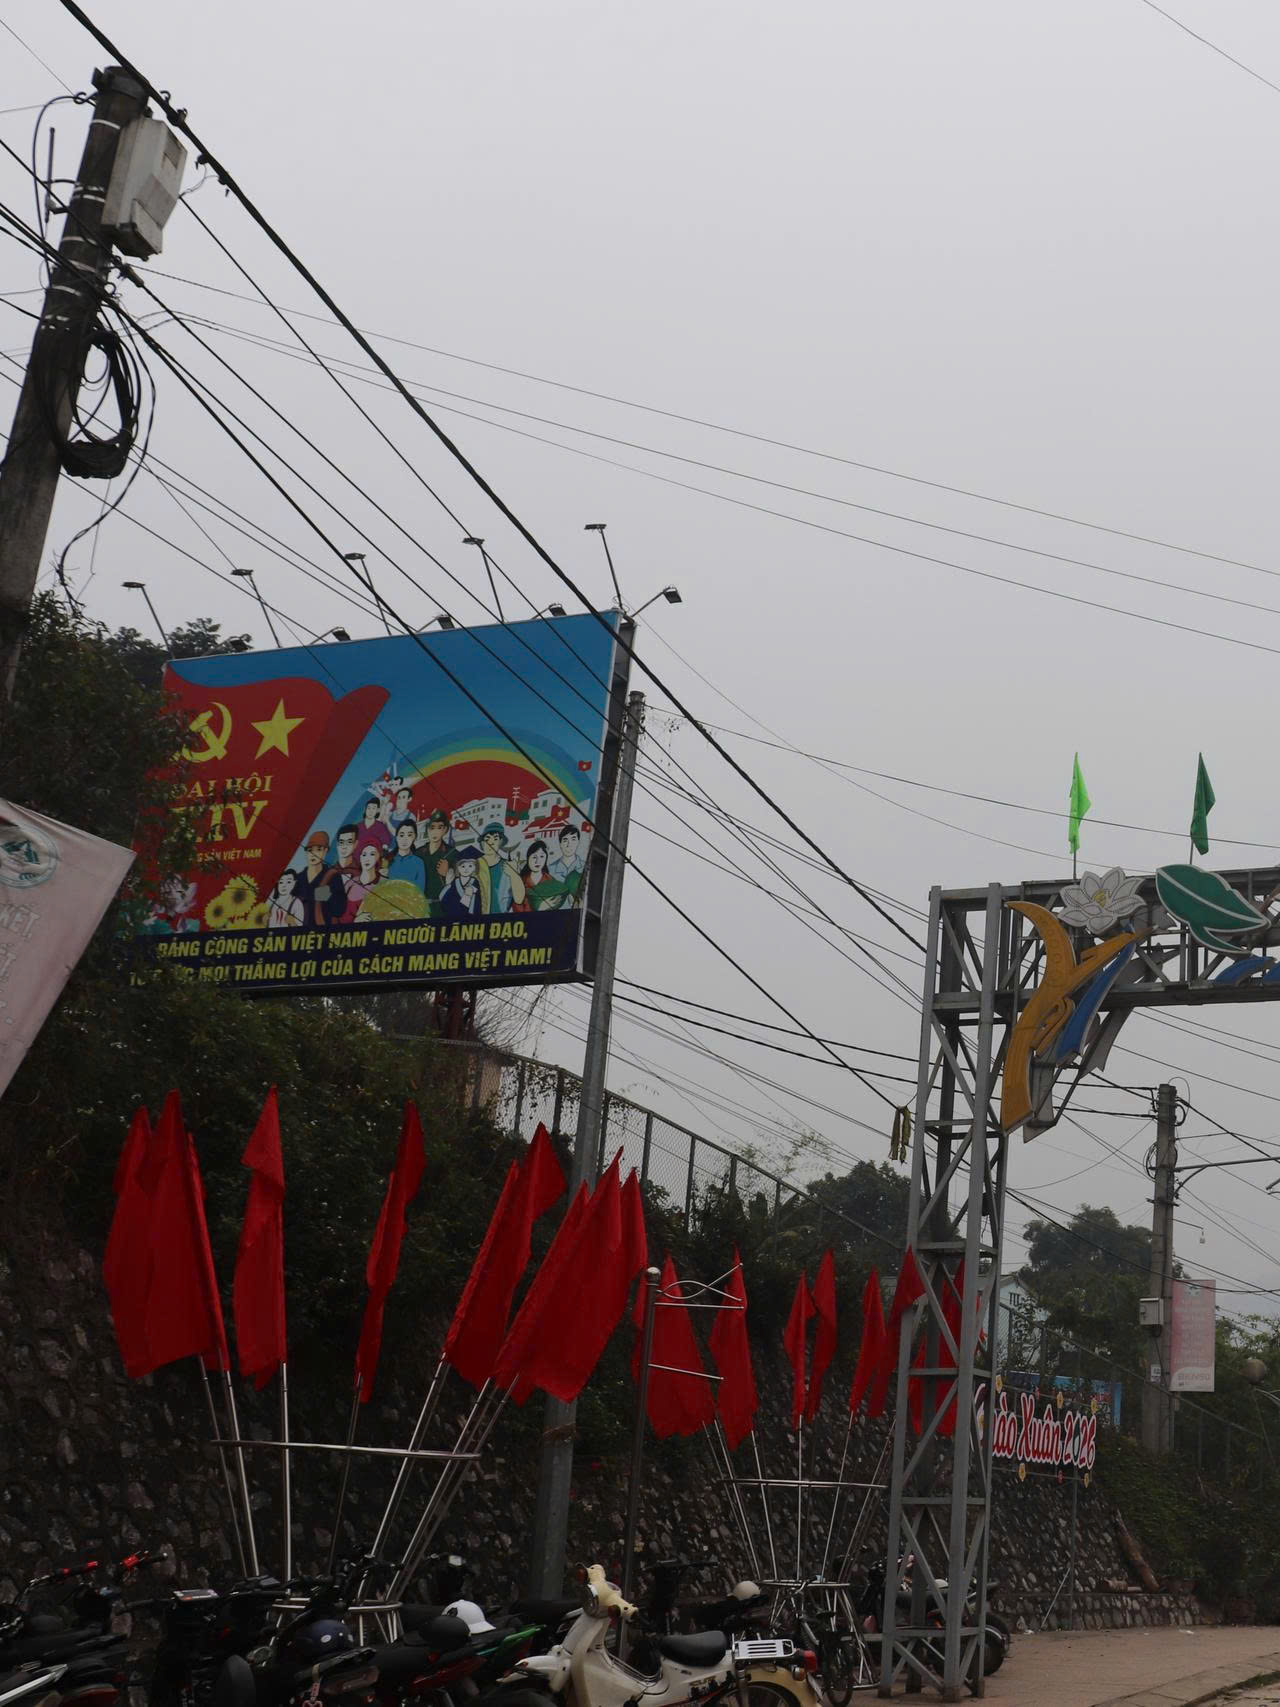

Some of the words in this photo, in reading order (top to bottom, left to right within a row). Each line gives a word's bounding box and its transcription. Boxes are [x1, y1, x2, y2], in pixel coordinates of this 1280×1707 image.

[224, 772, 273, 797] HỘI
[204, 935, 248, 958] CỘNG
[253, 931, 286, 954] SẢN
[291, 930, 325, 954] VIỆT
[329, 930, 368, 950] NAM
[383, 923, 435, 945] NGƯỜI
[440, 922, 485, 943] LÃNH
[489, 920, 528, 942] ĐẠO,
[234, 957, 286, 981] THẮNG
[290, 959, 316, 981] LỢI
[321, 953, 353, 976] CỦA
[358, 954, 403, 974] CÁCH
[408, 953, 459, 975] MẠNG
[464, 948, 500, 971] VIỆT
[504, 947, 552, 967] NAM!
[1017, 1392, 1063, 1466] Xuân
[1063, 1408, 1096, 1470] 2026
